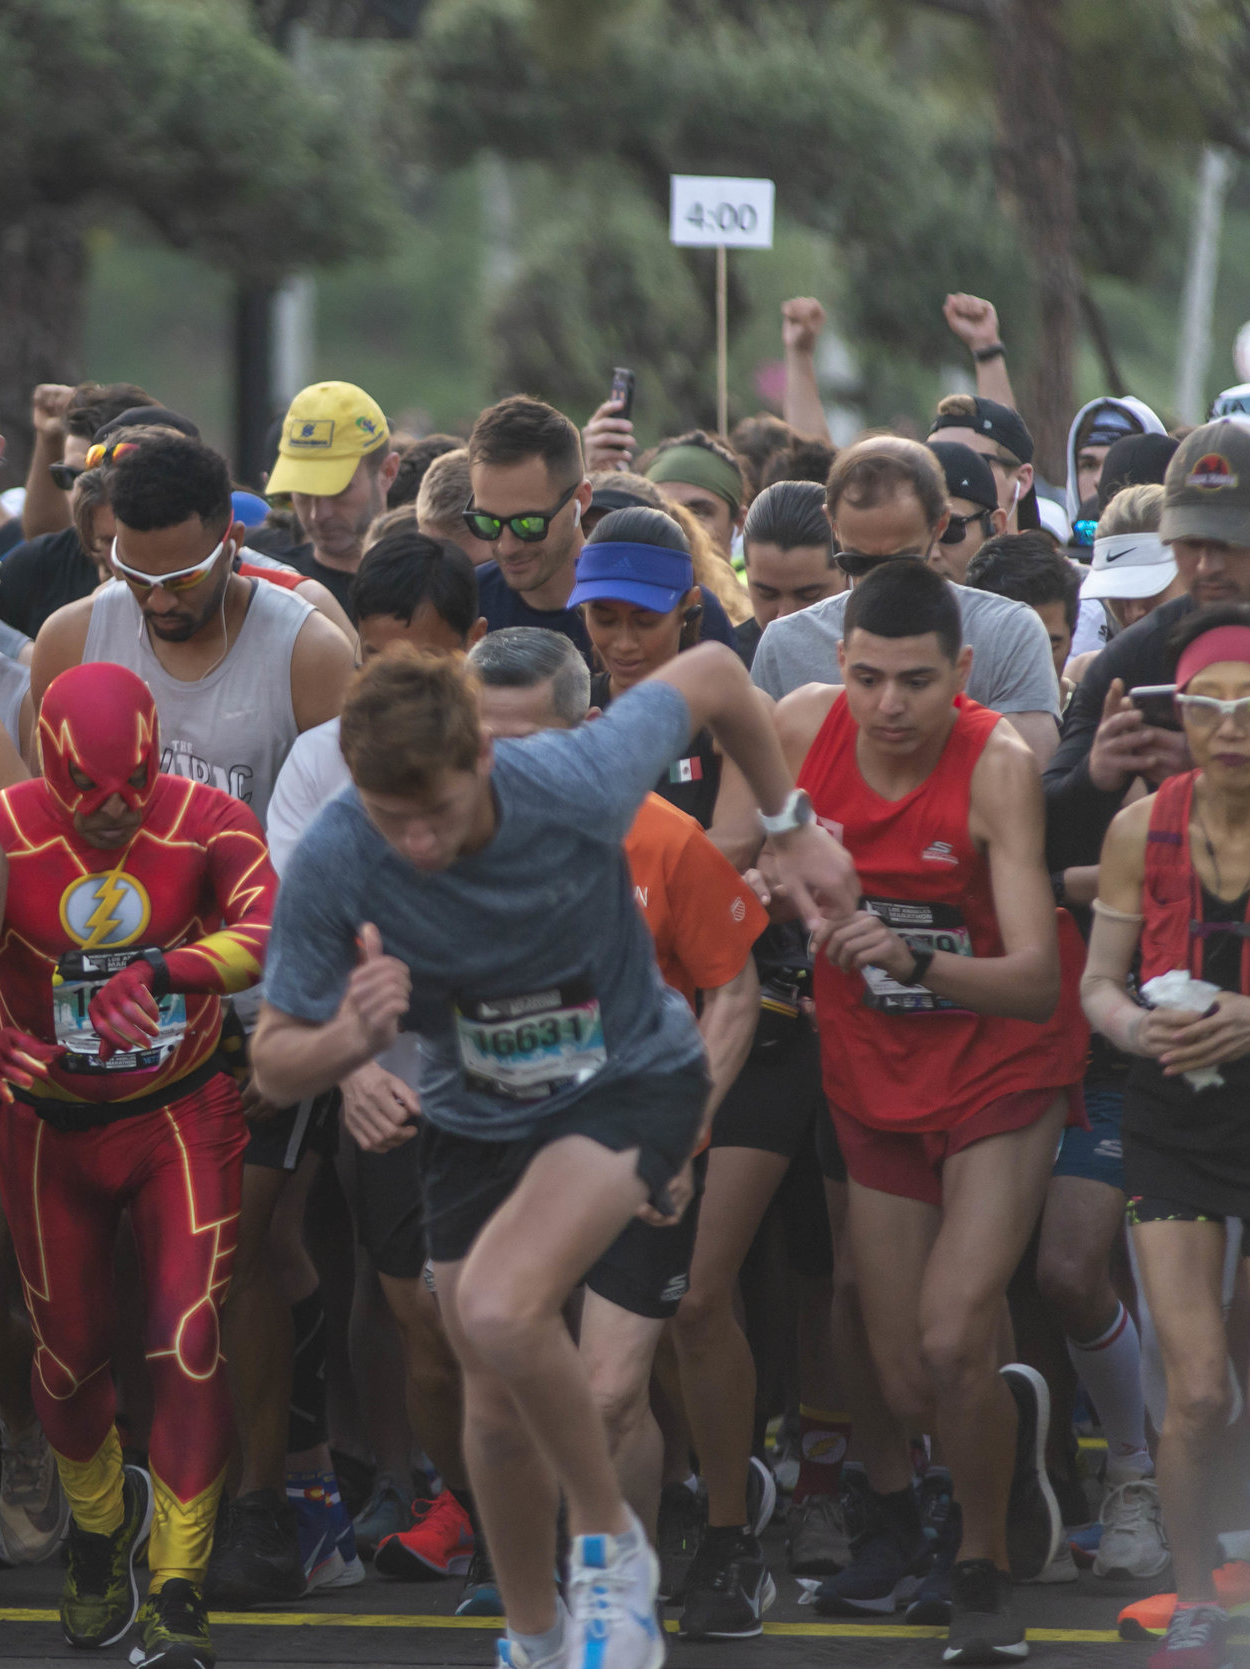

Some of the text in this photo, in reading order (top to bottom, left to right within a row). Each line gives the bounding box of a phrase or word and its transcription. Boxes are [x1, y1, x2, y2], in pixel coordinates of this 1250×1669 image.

[685, 201, 758, 235] 4:00
[172, 740, 193, 753] THE
[474, 1014, 583, 1057] 16631
